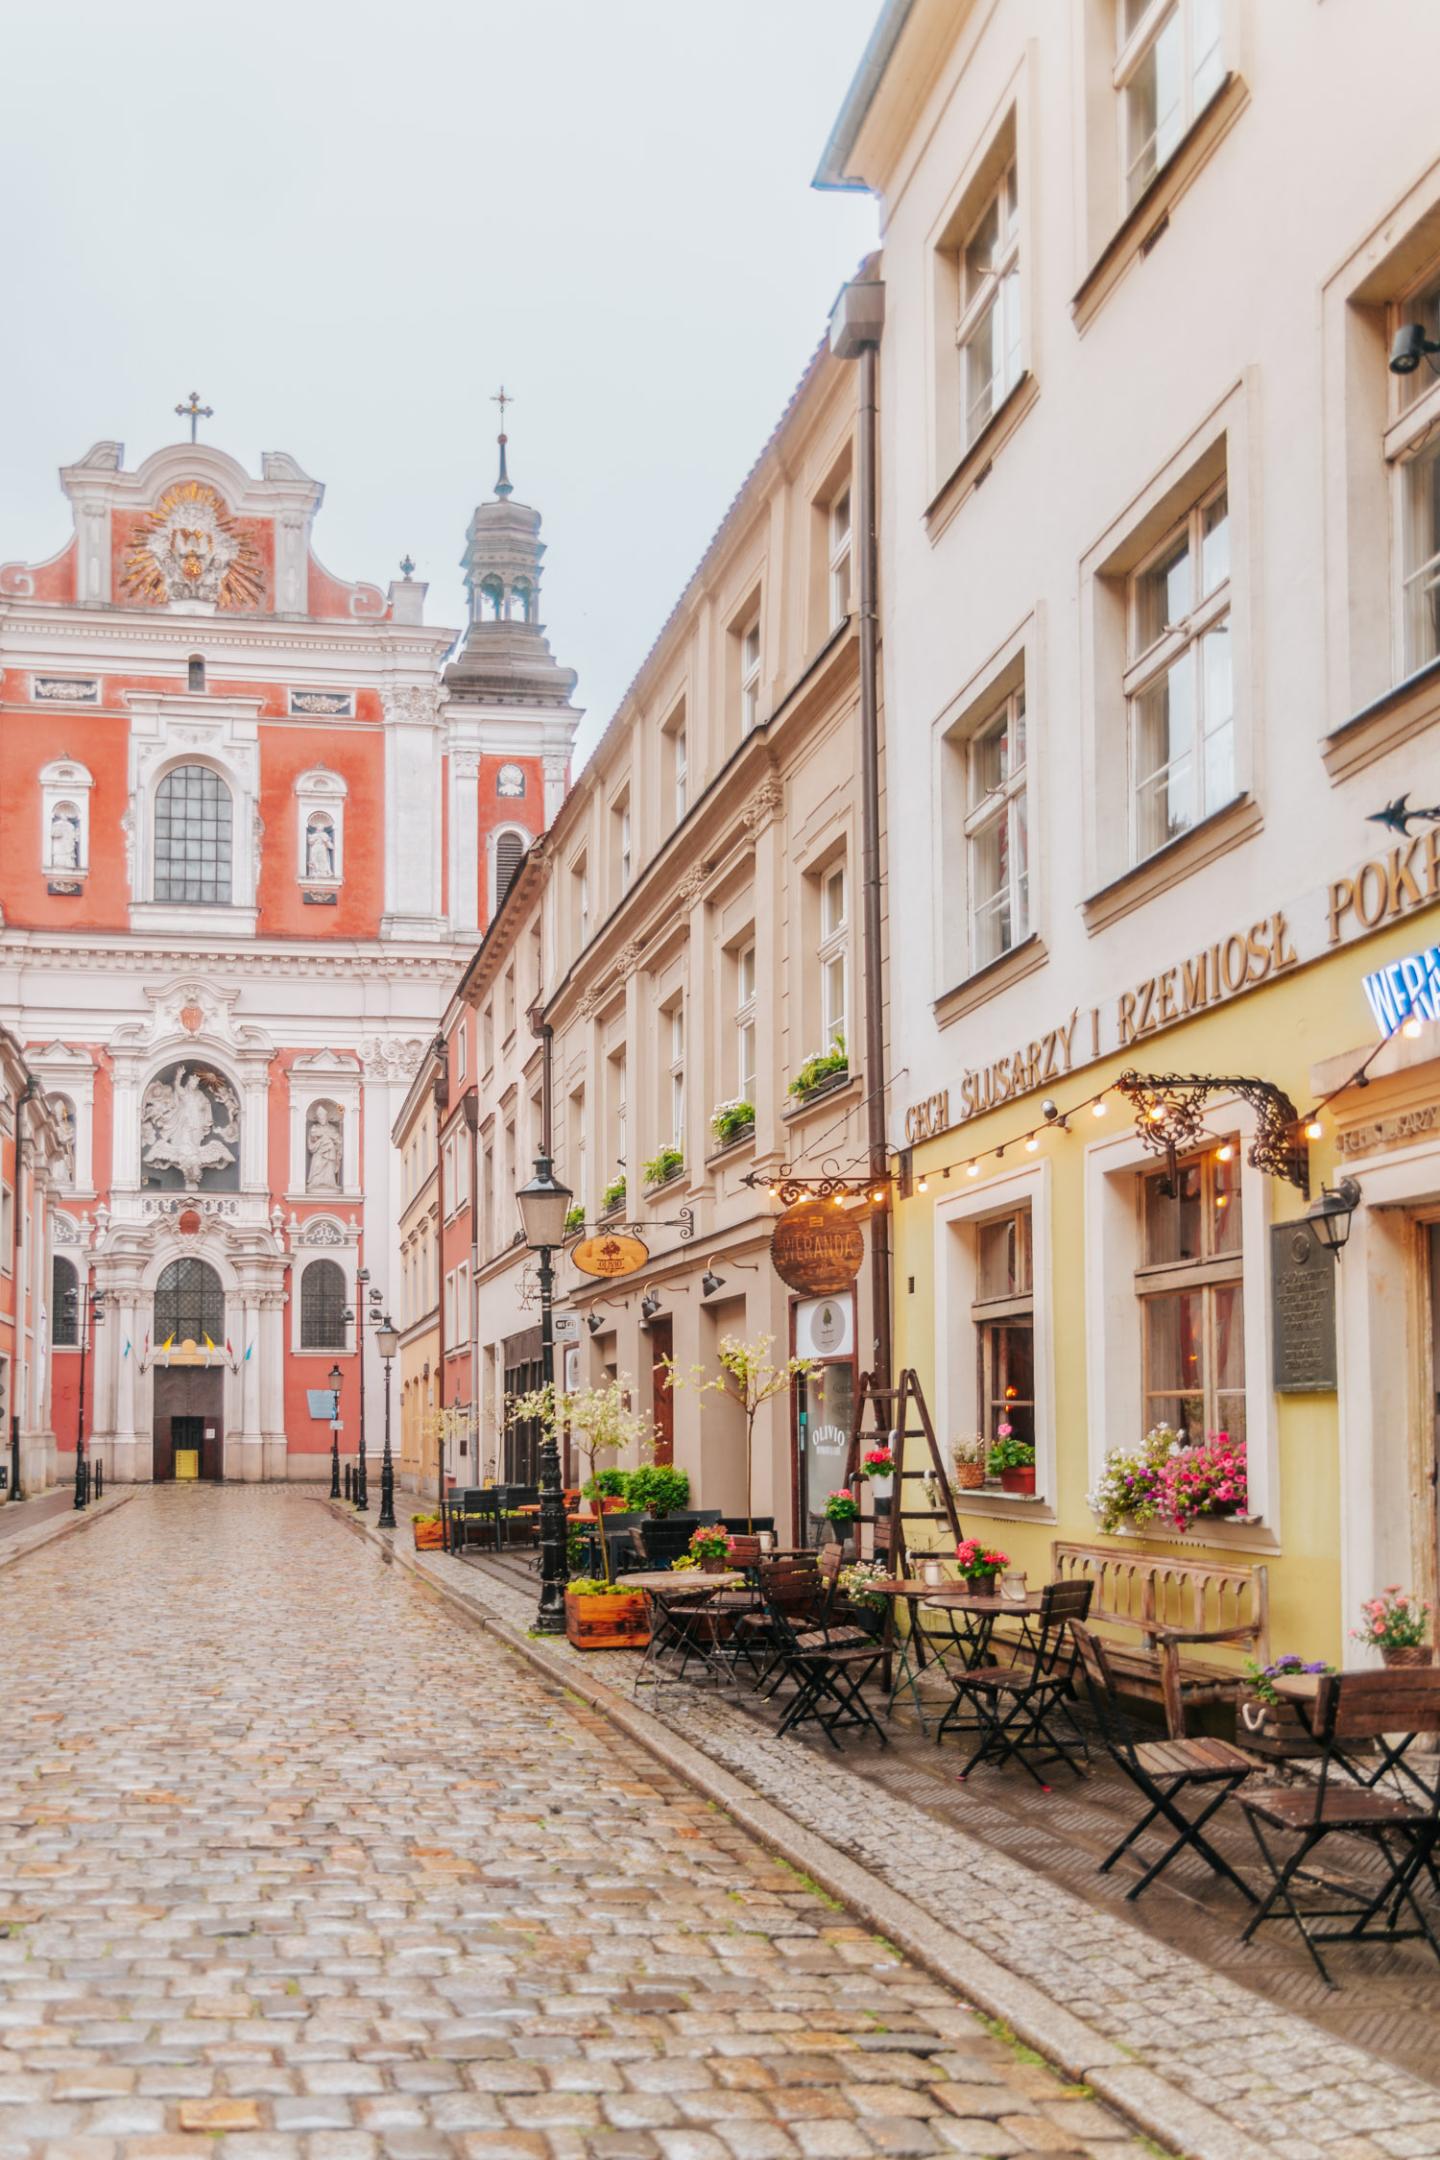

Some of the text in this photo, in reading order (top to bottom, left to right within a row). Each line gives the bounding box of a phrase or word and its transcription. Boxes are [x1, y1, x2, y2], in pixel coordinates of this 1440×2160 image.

[905, 1088, 951, 1145] CECH
[960, 1006, 1079, 1119] ŚLUSARZY
[1091, 1007, 1101, 1057] I
[1117, 910, 1298, 1045] RZEMIOSŁ
[812, 1425, 845, 1447] OLIVIO
